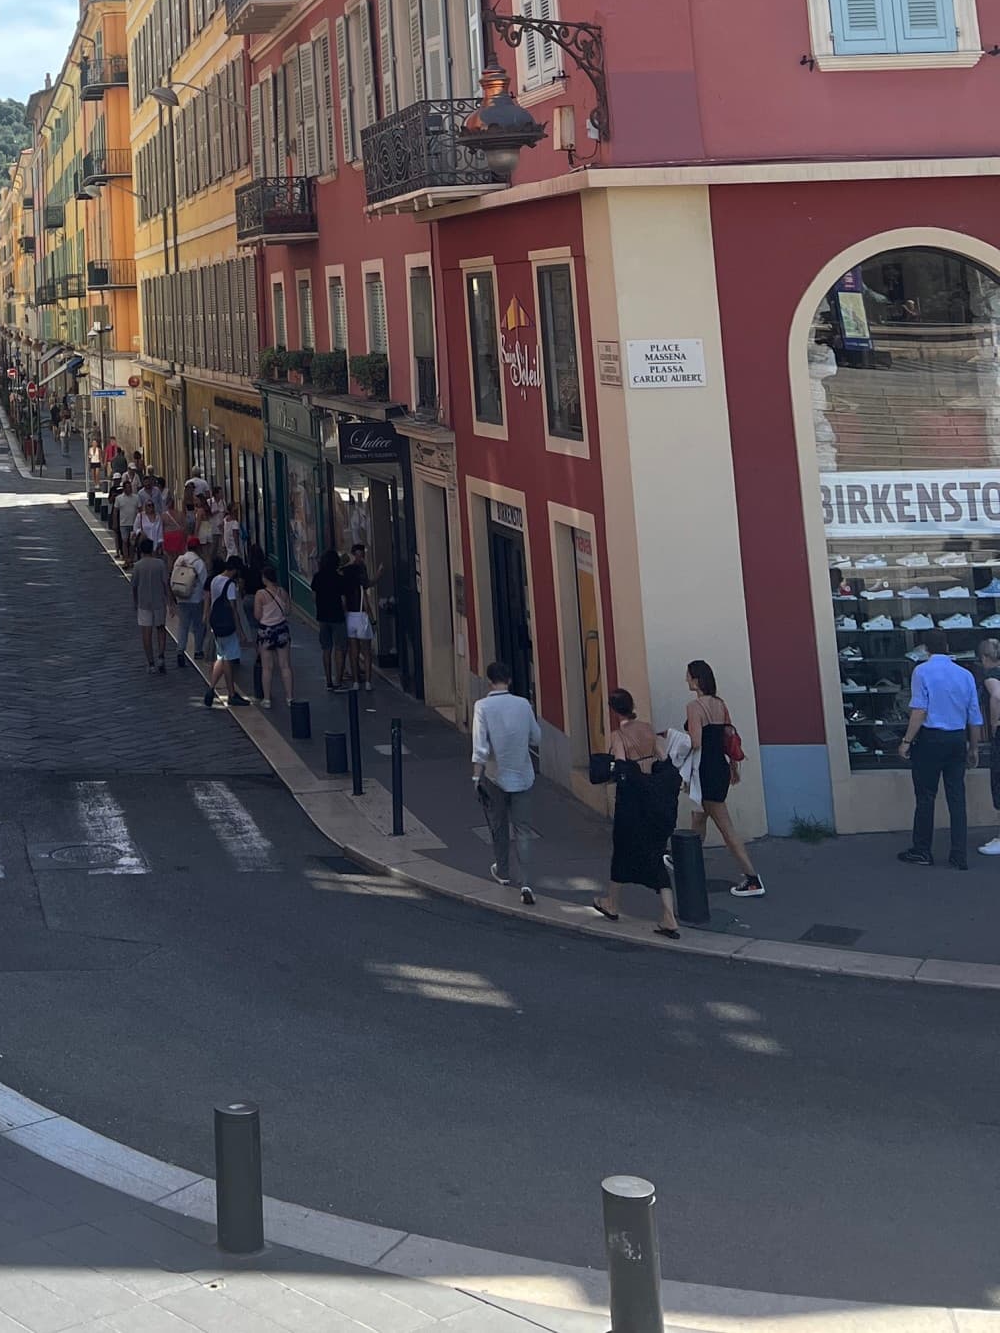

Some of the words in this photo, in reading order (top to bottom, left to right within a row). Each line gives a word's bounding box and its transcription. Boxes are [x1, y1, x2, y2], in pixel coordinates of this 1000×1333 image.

[650, 344, 681, 352] PLACE
[644, 353, 687, 361] MASSENA
[649, 365, 684, 373] PLASSA
[633, 375, 668, 383] CARLOU
[671, 374, 702, 382] AUBERT
